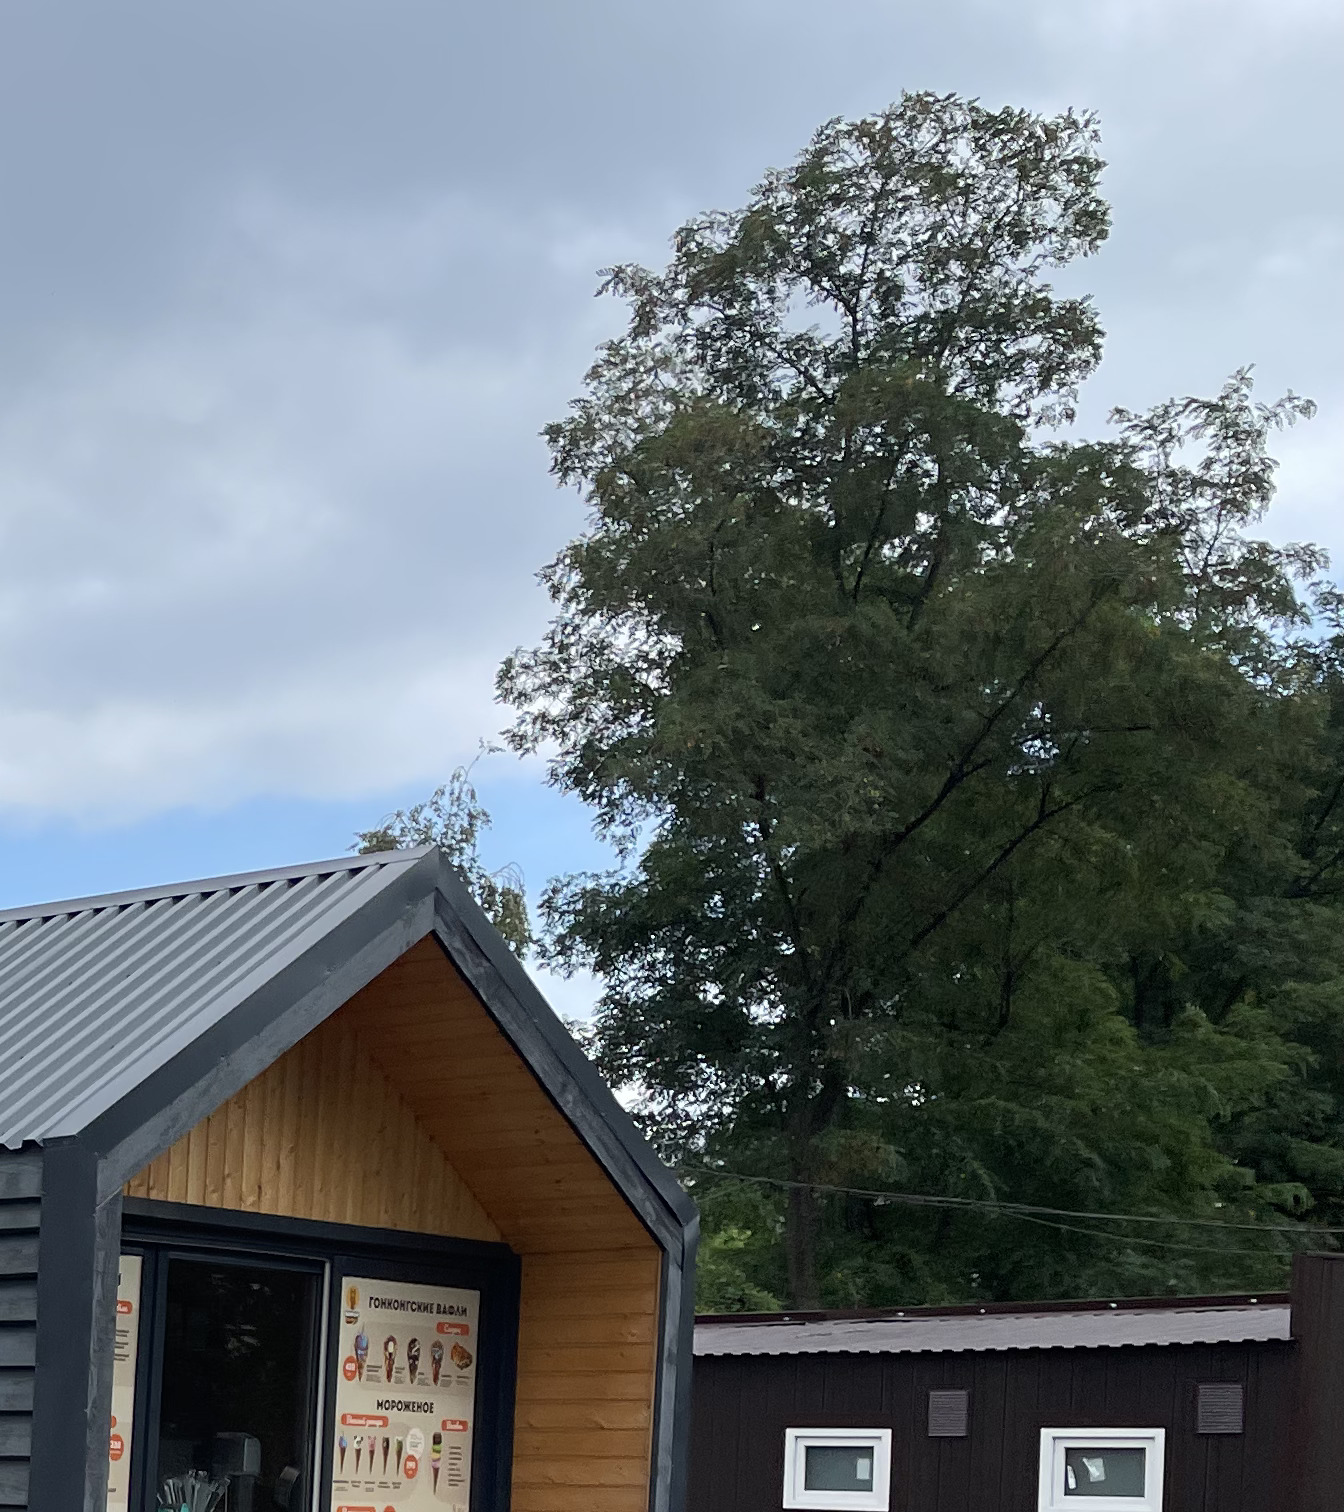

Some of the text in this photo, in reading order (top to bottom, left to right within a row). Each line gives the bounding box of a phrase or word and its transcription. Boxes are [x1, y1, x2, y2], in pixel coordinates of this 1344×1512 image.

[368, 1296, 468, 1317] ГОНКОНГСКИЕ ВАФЛИ
[376, 1399, 434, 1414] МОРОЖЕНОЕ
